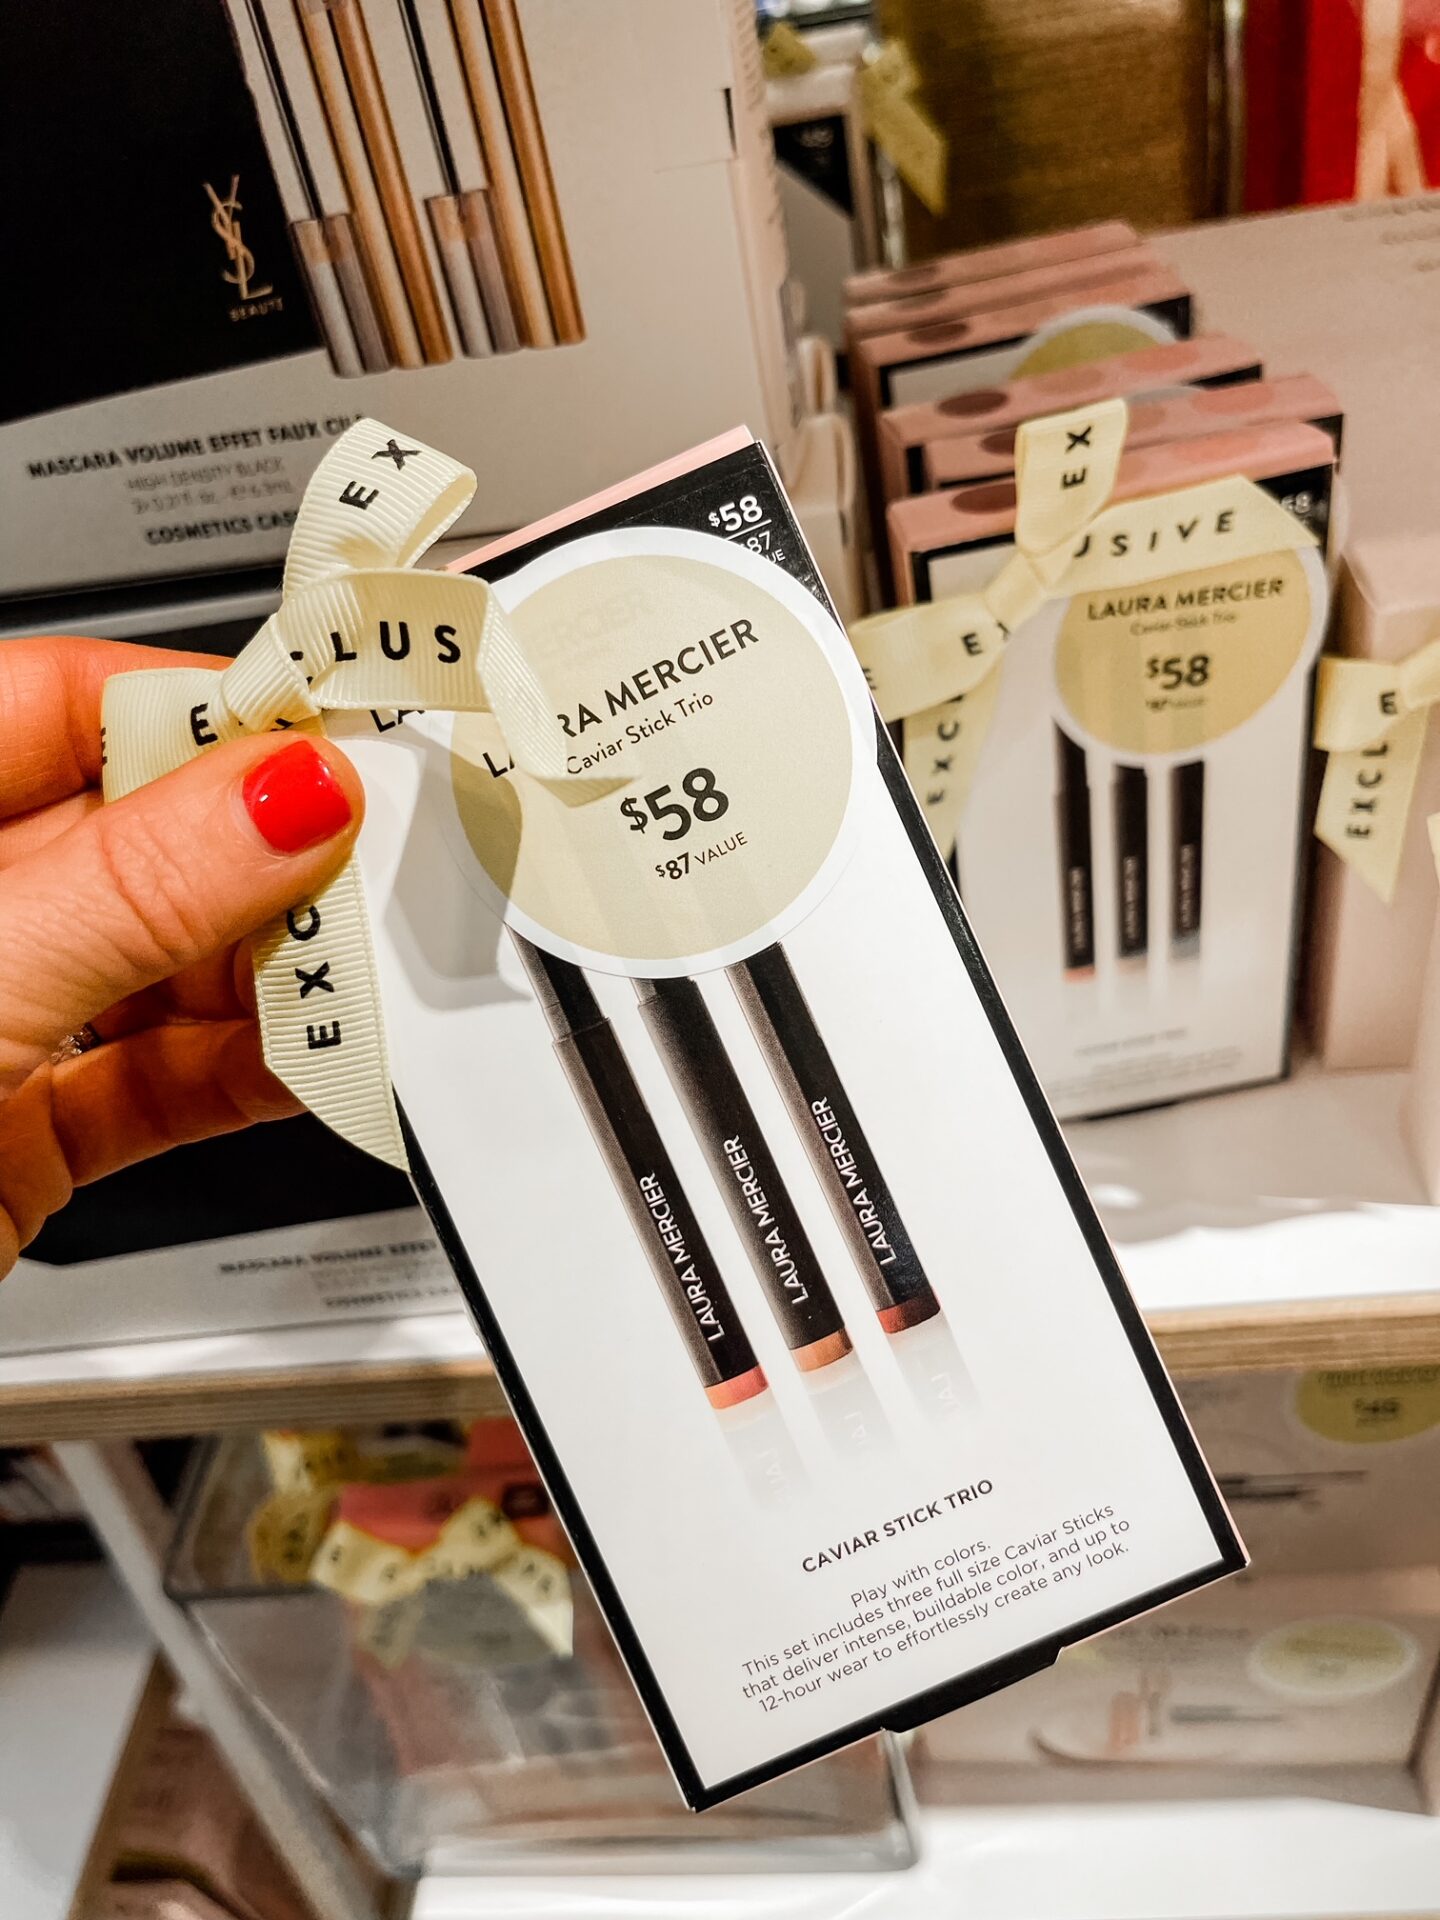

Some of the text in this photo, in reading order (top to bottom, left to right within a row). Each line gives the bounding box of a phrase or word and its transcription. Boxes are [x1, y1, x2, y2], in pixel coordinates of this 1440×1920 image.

[27, 448, 122, 479] MASCARA
[125, 438, 205, 465] VOLUME
[208, 427, 262, 452] EFFET
[266, 419, 321, 446] FAUX
[146, 514, 252, 546] COSMETICS
[708, 495, 763, 532] $58
[1087, 576, 1284, 621] LAURA MERCIER
[605, 618, 759, 717] MERCIER
[1146, 654, 1210, 691] $58
[566, 691, 714, 775] Caviar Stick Trio
[620, 767, 730, 842] $58
[654, 831, 748, 881] $87 VALUE
[723, 1134, 810, 1305] LAURA MERCIER
[811, 1096, 897, 1266] LAURA MERCIER
[639, 1173, 726, 1342] LAURA MERCIER
[801, 1479, 994, 1573] CAVIAR STICK TRIO
[741, 1505, 1114, 1677] This set includes three full size Caviar Sticks
[742, 1520, 1130, 1699] that deliver intense, buildable color, and up to
[850, 1540, 991, 1609] Play with colors.
[758, 1542, 1129, 1713] 12-hour wear to effortlessly create any look.
